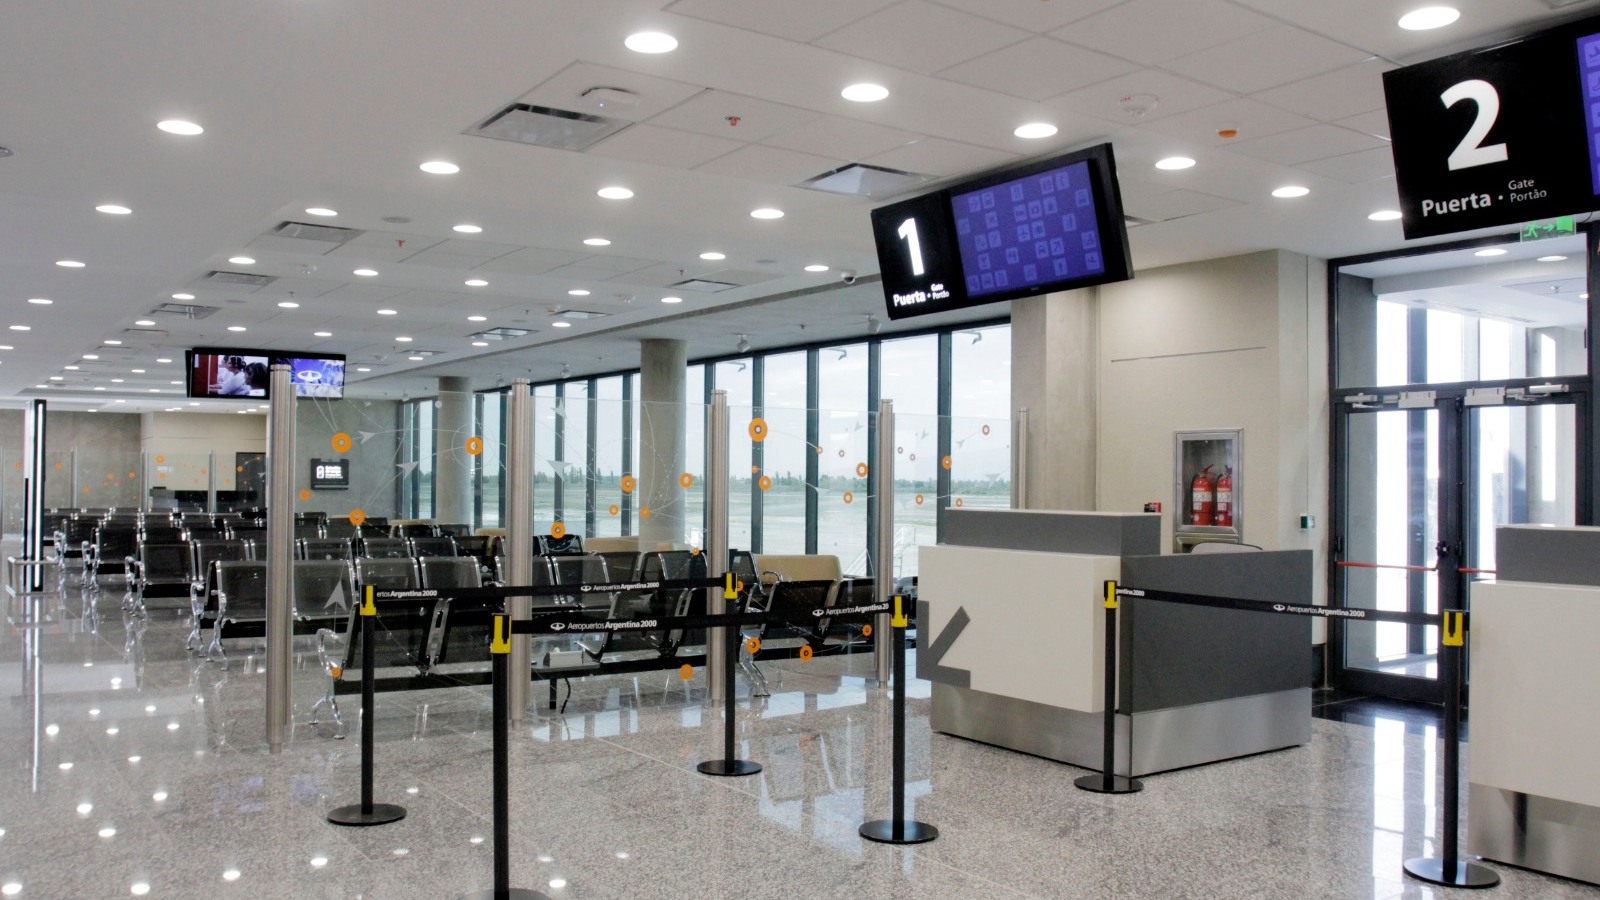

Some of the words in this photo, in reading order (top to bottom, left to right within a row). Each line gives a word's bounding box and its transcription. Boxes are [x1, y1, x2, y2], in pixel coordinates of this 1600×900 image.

[1440, 79, 1508, 171] 2
[1508, 178, 1535, 190] Gate
[1509, 188, 1547, 203] Portão
[1421, 192, 1492, 217] Puerta
[897, 217, 924, 276] 1
[893, 291, 926, 307] Puerta
[391, 590, 422, 598] Argentina
[825, 608, 855, 616] Aeropuertos
[854, 603, 882, 614] Argentina
[1286, 605, 1318, 614] Aeropuertos
[1318, 607, 1349, 616] Argentina
[1349, 609, 1365, 617] 2000
[568, 622, 605, 631] Aeropuertos
[604, 620, 641, 631] Argentina
[640, 620, 658, 628] 2000
